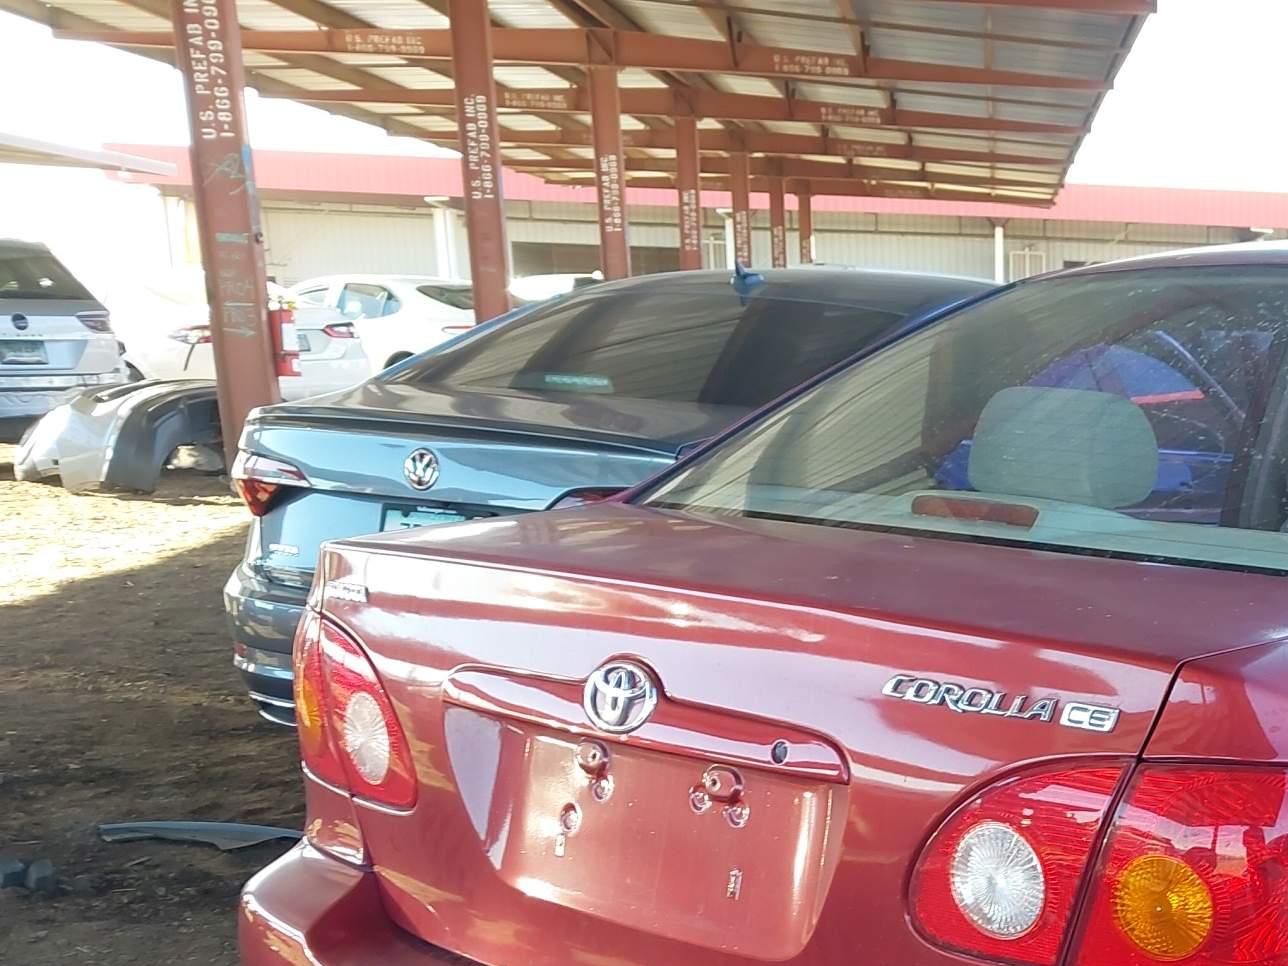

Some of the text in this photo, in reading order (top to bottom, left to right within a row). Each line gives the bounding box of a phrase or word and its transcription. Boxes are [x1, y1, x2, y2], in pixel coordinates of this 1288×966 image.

[186, 23, 212, 95] PREFAB
[199, 105, 218, 140] U.S.
[465, 122, 480, 171] PREFAB
[882, 673, 1117, 731] COROLLA CE
